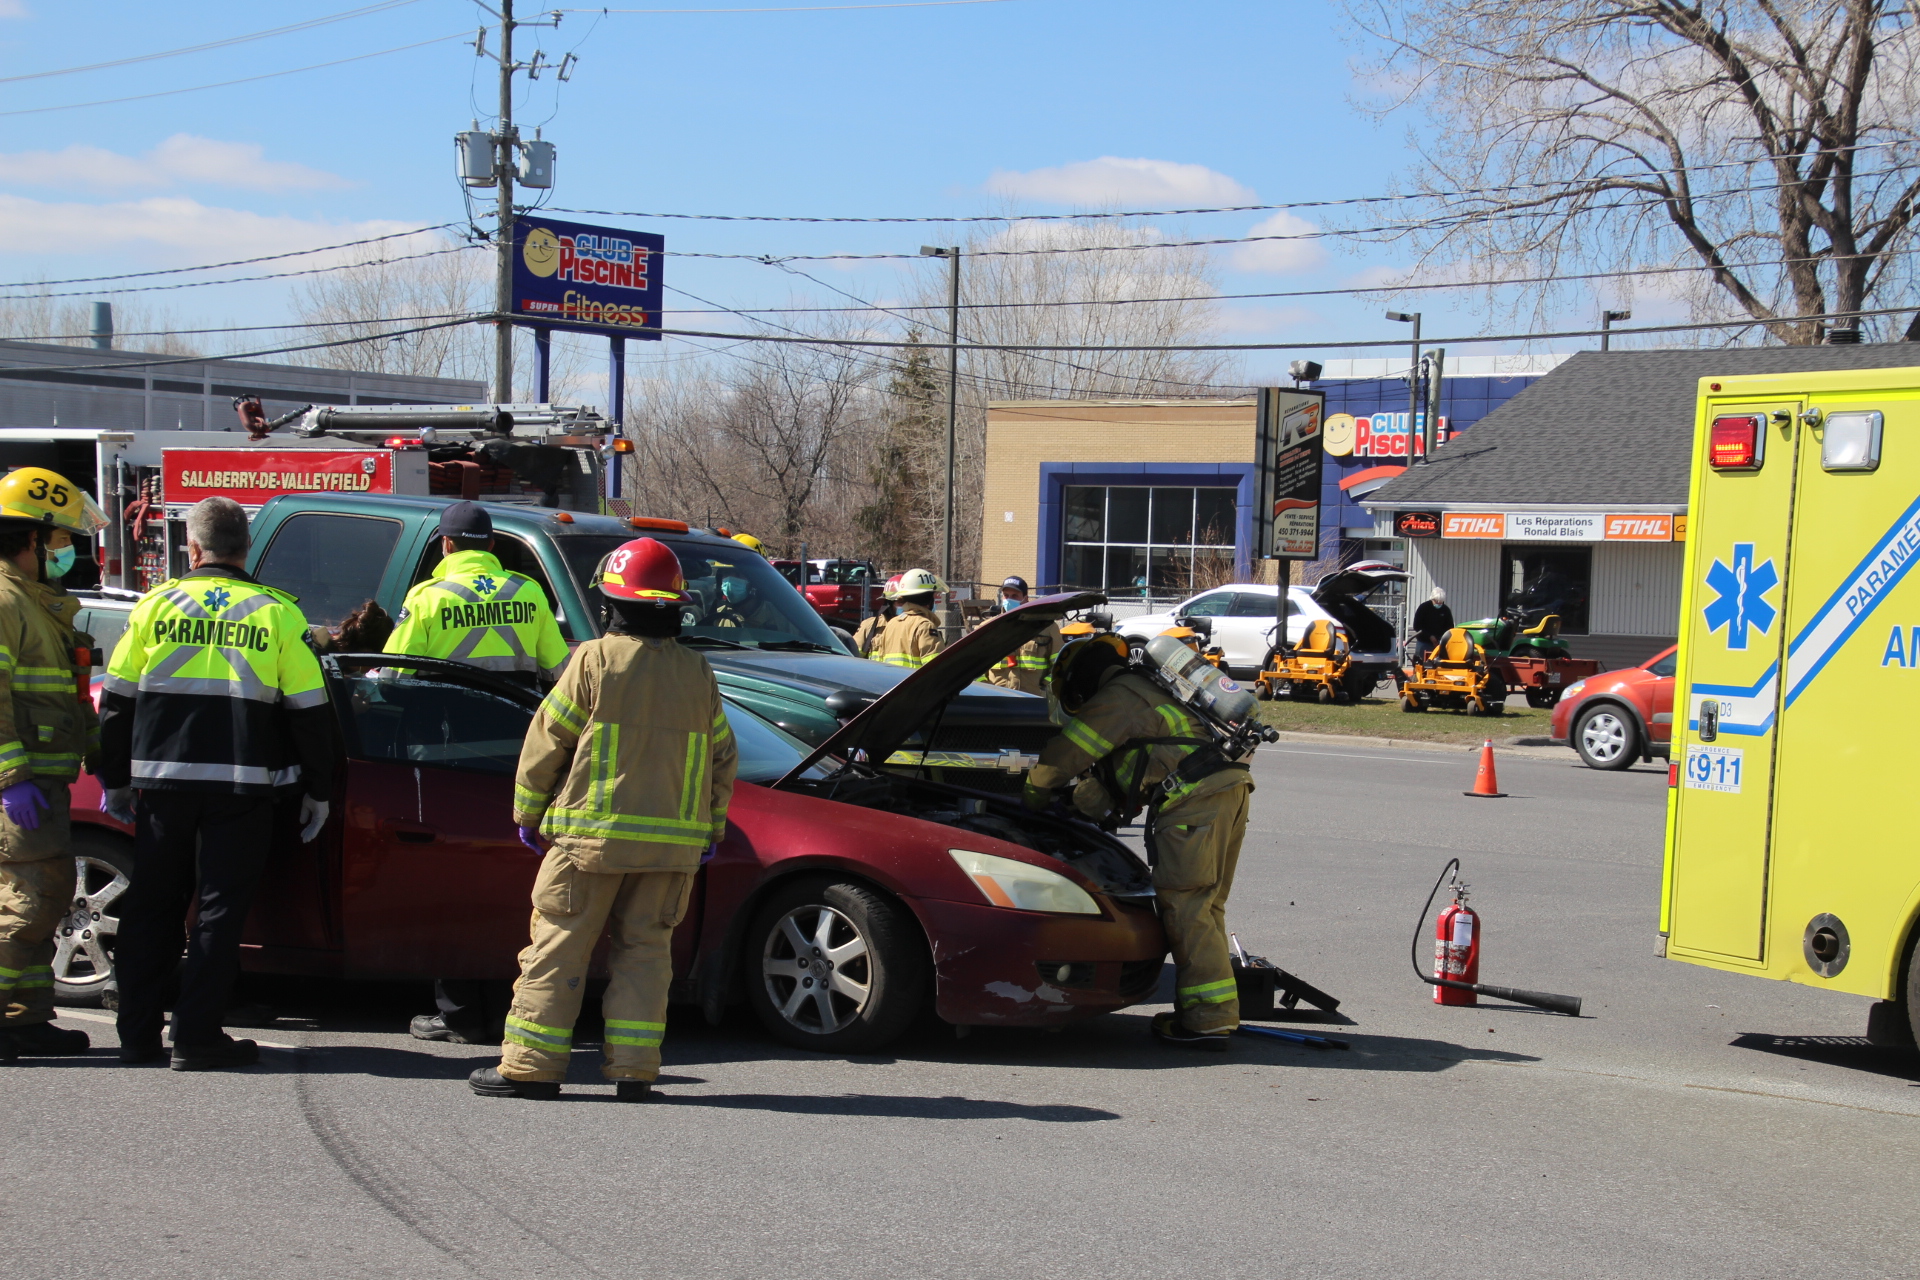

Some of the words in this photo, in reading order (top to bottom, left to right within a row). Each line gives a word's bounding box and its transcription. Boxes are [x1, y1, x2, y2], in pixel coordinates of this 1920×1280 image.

[576, 233, 632, 262] CLUB
[558, 235, 648, 290] PISCINE
[530, 301, 559, 311] SUPER
[563, 290, 644, 327] Fitness
[181, 470, 371, 491] SALABERRY-DE-VALLEYFIELD
[28, 477, 69, 508] 35
[1401, 515, 1436, 530] Ariens
[1445, 517, 1500, 533] STIHL
[1516, 517, 1533, 526] Les
[1535, 516, 1593, 528] Réparations
[1607, 519, 1667, 536] STIHL
[1524, 527, 1557, 536] Ronald
[1560, 527, 1584, 537] Blais
[917, 573, 937, 584] 110
[441, 601, 537, 630] PARAMEDIC
[154, 619, 269, 652] PARAMEDIC
[1720, 702, 1732, 717] D3
[1693, 783, 1732, 792] EMERGENCY
